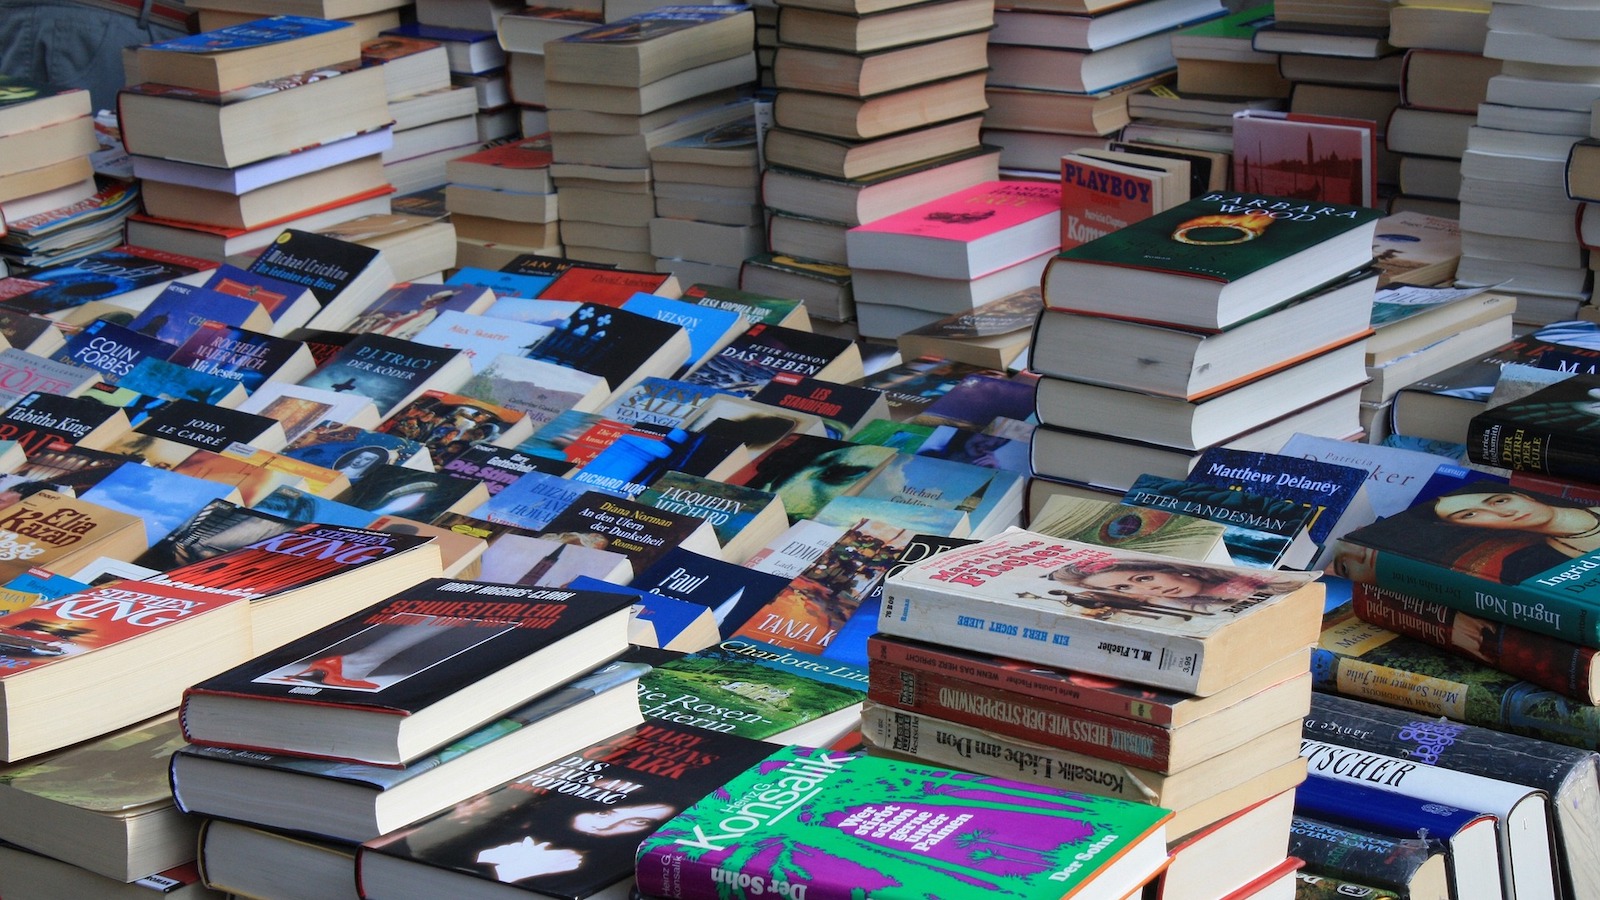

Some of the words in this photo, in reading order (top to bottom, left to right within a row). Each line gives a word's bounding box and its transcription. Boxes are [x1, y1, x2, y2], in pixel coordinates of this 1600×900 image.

[1064, 163, 1151, 203] PLAYBOY
[1202, 193, 1358, 219] BARBARA
[1218, 203, 1318, 222] WOOD
[304, 259, 349, 281] Crichton
[521, 259, 551, 269] JAN
[74, 346, 134, 376] FORBES
[89, 336, 140, 361] COLIN
[376, 349, 437, 370] TRACY
[720, 345, 754, 363] DAS
[760, 354, 822, 377] BEBEN
[748, 342, 781, 356] PETER
[784, 351, 830, 366] HERNON
[346, 358, 374, 373] DER
[374, 364, 416, 381] KÖDER
[810, 386, 832, 400] LES
[6, 406, 59, 430] Tabitha
[56, 416, 92, 437] King
[185, 417, 225, 433] JOHN
[157, 423, 175, 434] LE
[177, 428, 227, 447] CARRÉ
[1324, 451, 1373, 467] Patricia
[1502, 435, 1513, 462] DER
[1513, 428, 1525, 471] SCHREI
[1522, 440, 1532, 464] DER
[1531, 436, 1542, 470] EULE
[444, 459, 479, 475] Die
[1207, 462, 1275, 485] Matthew
[1276, 472, 1342, 497] Delaney
[530, 482, 577, 501] ELIZAB
[575, 471, 624, 489] RICHARD
[620, 481, 650, 495] NOR
[897, 484, 944, 501] Michael
[653, 498, 729, 527] MITCHARD
[659, 486, 747, 516] JACQUELYN
[1133, 491, 1179, 509] PETER
[1183, 500, 1287, 531] LANDESMAN
[36, 508, 98, 535] Elia
[579, 506, 594, 517] An
[592, 509, 614, 523] den
[616, 515, 644, 531] Ufern
[600, 501, 631, 518] Diana
[632, 510, 673, 527] Norman
[0, 507, 83, 548] Kazan
[310, 528, 398, 547] STEPHEN
[590, 520, 609, 534] der
[609, 524, 665, 547] Dunkelheit
[245, 532, 397, 565] KING
[612, 538, 643, 552] Roman
[781, 541, 823, 561] EDMO
[929, 554, 990, 582] Marie
[982, 540, 1045, 560] Louise
[949, 544, 1072, 587] Fischer
[1536, 559, 1591, 588] Ingrid
[657, 567, 710, 595] Paul
[1564, 577, 1597, 595] Der
[30, 592, 194, 627] KING
[91, 588, 206, 611] STEPHEN
[900, 598, 910, 622] Roman
[1224, 591, 1276, 614] ROMAN
[1474, 591, 1508, 615] Noll
[957, 615, 986, 631] LIEBE
[1365, 600, 1396, 626] Lapid
[1426, 602, 1448, 623] Der
[1512, 601, 1562, 631] Ingrid
[757, 613, 812, 643] TANJA
[988, 622, 1018, 638] SUCHT
[1022, 628, 1048, 643] HERZ
[1052, 632, 1070, 646] EIN
[1397, 613, 1446, 645] Shulamit
[719, 639, 829, 673] Charlotte
[828, 666, 869, 683] Lin
[905, 653, 938, 669] SPRICHT
[1097, 640, 1131, 657] Fischer
[938, 660, 959, 674] HERZ
[959, 664, 977, 677] DAS
[978, 668, 999, 681] WENN
[1182, 653, 1191, 674] 3,95
[1005, 676, 1033, 690] Fischer
[1033, 681, 1057, 694] Louise
[1345, 669, 1372, 685] Julia
[1372, 675, 1390, 688] mit
[1391, 678, 1431, 698] Sommer
[1058, 686, 1081, 700] Marie
[1361, 685, 1414, 706] WOODHOUSE
[1415, 697, 1442, 712] SARAH
[1432, 685, 1459, 704] Mein
[639, 702, 737, 734] chterin
[666, 693, 772, 725] Rosen-
[938, 686, 1022, 727] STEPPENWIND
[1022, 709, 1047, 732] DER
[1046, 713, 1072, 739] WIE
[1320, 722, 1370, 740] Janice
[638, 726, 711, 748] MARY
[934, 729, 973, 758] Don
[1071, 720, 1109, 747] HEISS
[1110, 729, 1154, 758] KONSALIK
[582, 745, 696, 780] CLARK
[609, 735, 721, 767] HIGGINS
[973, 743, 1003, 759] am
[1003, 747, 1055, 778] Liebe
[560, 756, 611, 773] DAS
[517, 773, 627, 805] POTOMAC
[539, 765, 600, 785] HAUS
[603, 778, 644, 794] AM
[1056, 761, 1126, 794] Konsalik
[675, 752, 856, 852] Konsalik
[720, 787, 762, 813] Heinz
[839, 806, 877, 828] Wer
[854, 804, 902, 837] stirbt
[871, 808, 917, 839] schon
[888, 810, 933, 842] gerne
[904, 812, 950, 844] unter
[911, 812, 974, 852] Palmen
[1048, 857, 1080, 882] Der
[1078, 834, 1119, 867] Sohn
[1341, 836, 1387, 855] NANCY
[660, 866, 672, 898] Heinz
[672, 854, 683, 899] Konsalik
[710, 868, 766, 895] Sohn
[771, 881, 808, 900] Der
